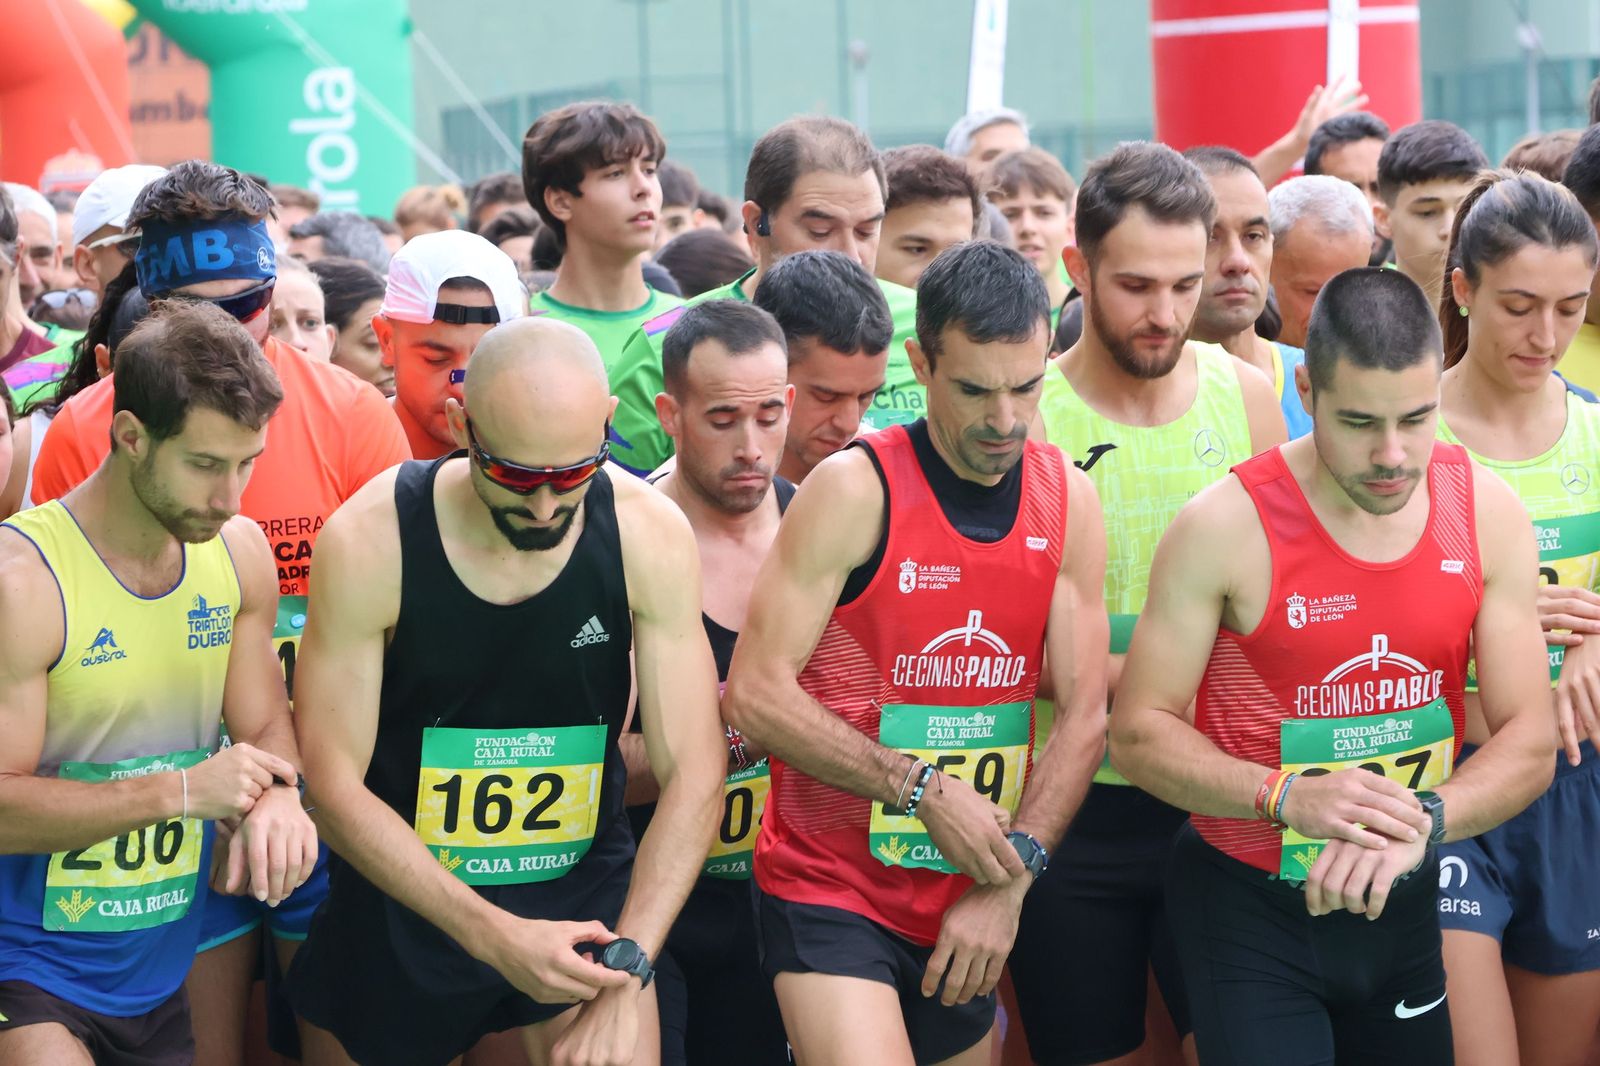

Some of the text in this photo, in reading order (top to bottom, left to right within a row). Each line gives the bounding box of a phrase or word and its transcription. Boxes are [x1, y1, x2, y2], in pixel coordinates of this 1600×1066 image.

[288, 66, 359, 210] rola
[873, 384, 923, 409] cha
[256, 515, 324, 537] RRERA
[278, 566, 310, 580] ADR
[1322, 594, 1356, 603] BAÑEZA
[1309, 604, 1357, 615] DIPUTACIÓN
[1323, 613, 1344, 621] LEÓN
[81, 650, 127, 667] austral
[927, 727, 993, 739] CAJA RURAL
[1333, 731, 1413, 751] CAJA RURAL
[474, 746, 555, 759] CAJA RURAL
[1347, 748, 1379, 758] ZAMORA
[433, 773, 564, 834] 162
[911, 846, 943, 860] CAJ
[466, 852, 580, 874] CAJA RURAL
[707, 861, 747, 873] CAJA
[98, 888, 189, 917] CAJA RURAL
[1440, 897, 1482, 916] arsa
[1587, 927, 1600, 939] ZA
